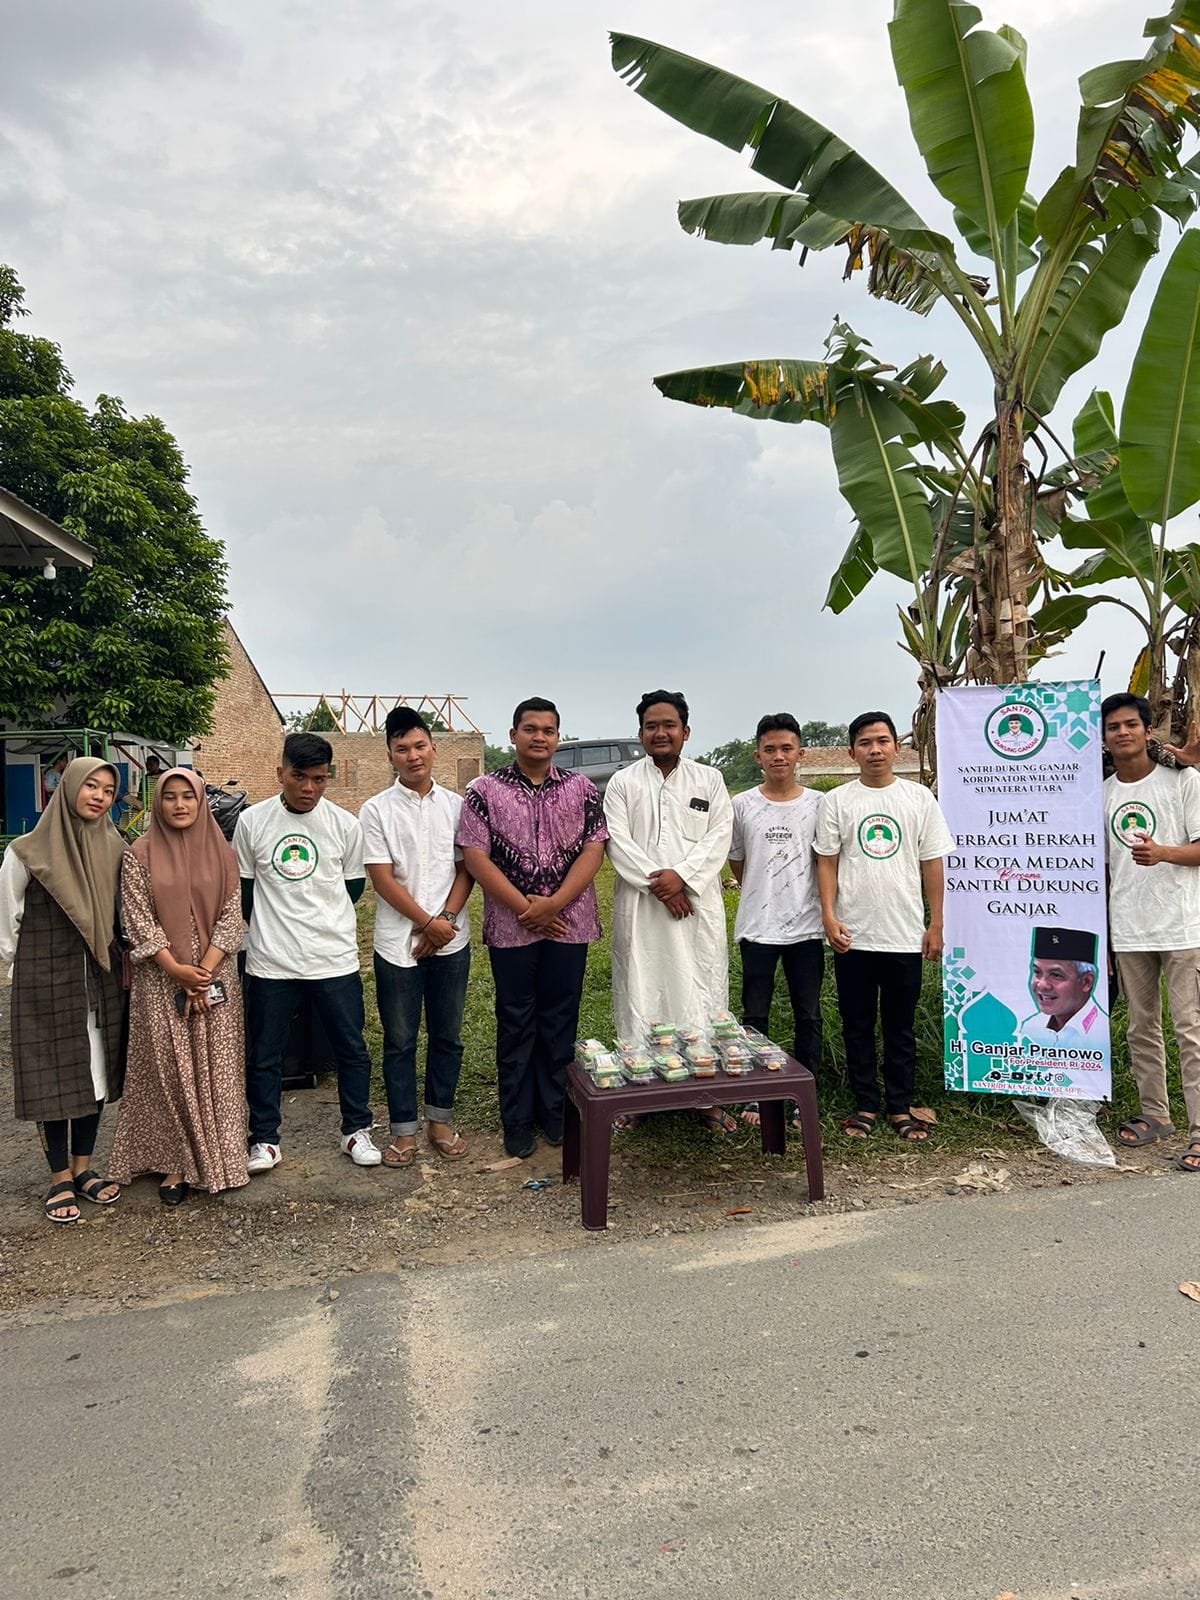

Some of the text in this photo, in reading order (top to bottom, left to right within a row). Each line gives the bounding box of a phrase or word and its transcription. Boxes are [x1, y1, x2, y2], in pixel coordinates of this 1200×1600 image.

[1000, 706, 1033, 716] SANTRI
[994, 737, 1039, 753] DUKUNG GANJAR
[958, 763, 1079, 774] SANTRI DUKUNG GANJAR
[962, 773, 1075, 784] KORDINATOR WILAYAH
[975, 784, 1063, 794] SUMATERA UTARA
[283, 837, 309, 846] SANTRI
[952, 832, 1096, 846] ERBAGI BERKAH
[974, 855, 1021, 869] KOTA
[1027, 856, 1095, 869] MEDAN
[997, 867, 1041, 881] Bersama
[946, 877, 1099, 893] SANTRI DUKUNG
[987, 900, 1059, 918] GANJAR
[951, 1040, 1103, 1061] H. Ganjar Pranowo
[1009, 1057, 1024, 1066] For
[1026, 1058, 1067, 1067] President
[1080, 1062, 1102, 1070] 2024
